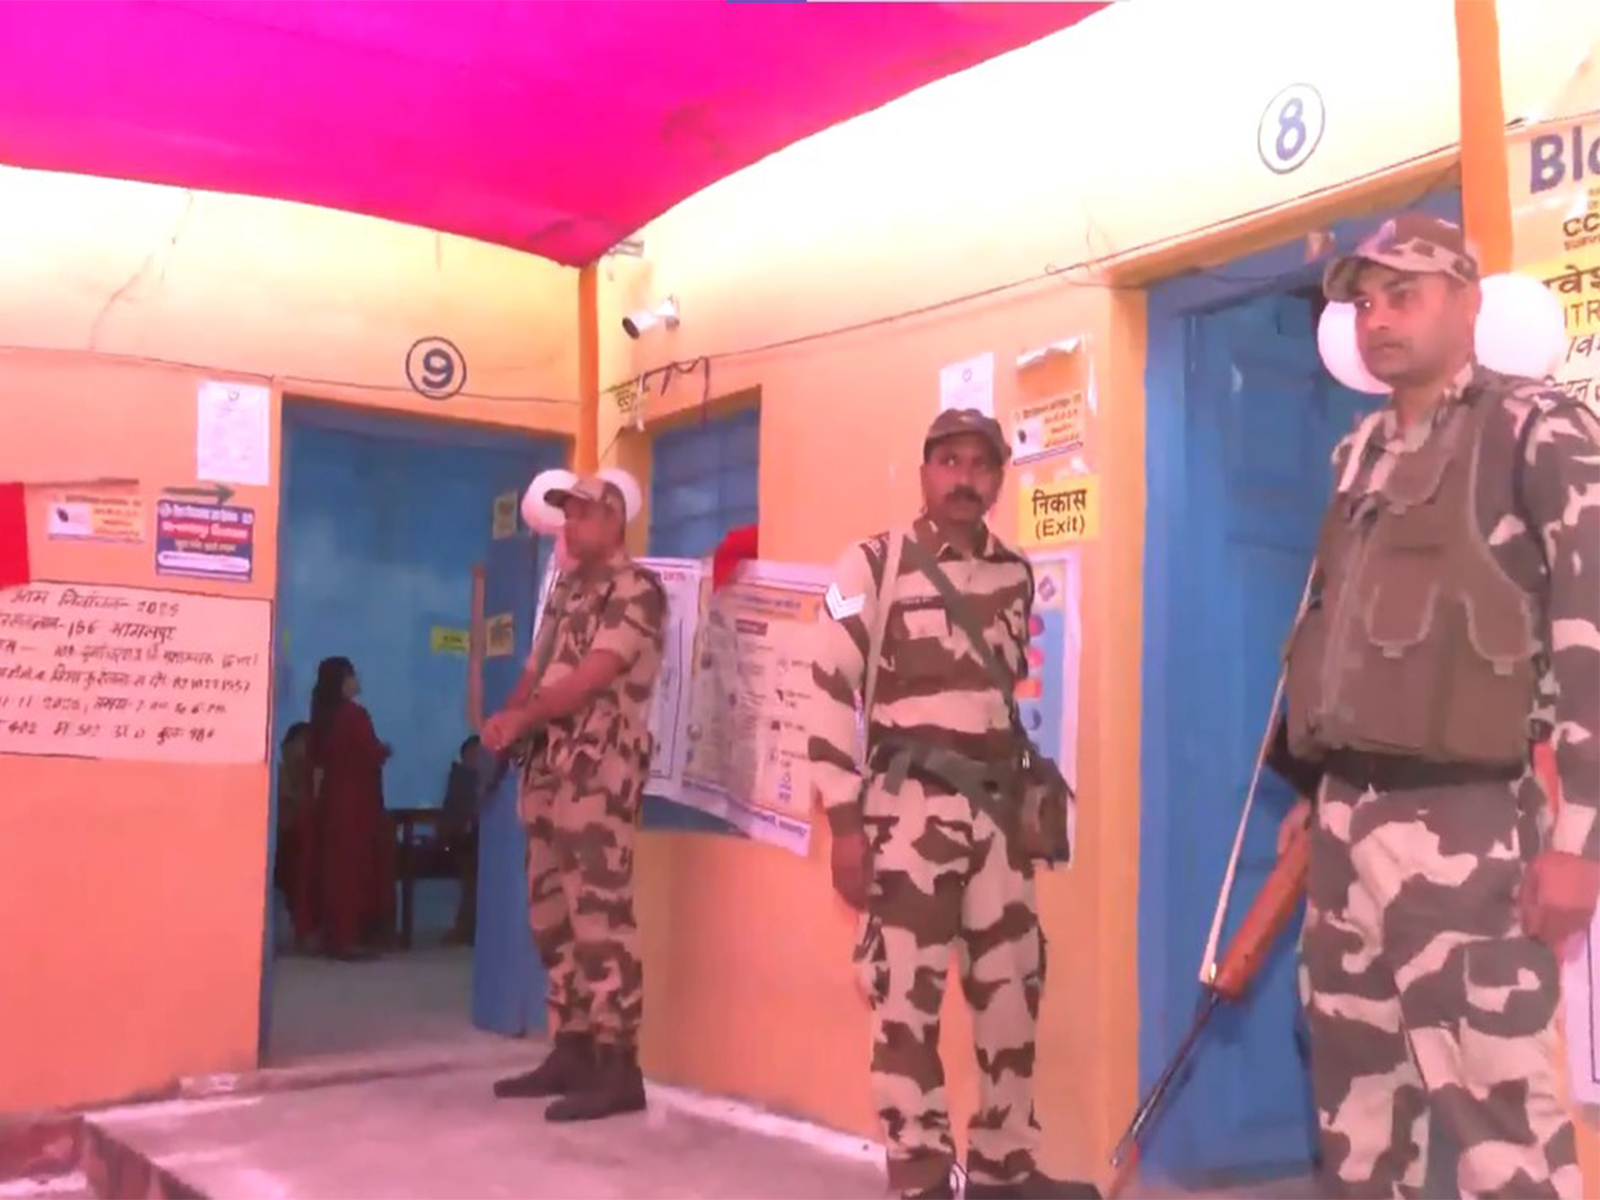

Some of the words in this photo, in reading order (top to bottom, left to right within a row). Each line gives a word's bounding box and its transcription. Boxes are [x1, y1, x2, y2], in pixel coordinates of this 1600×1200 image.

[1276, 97, 1306, 161] 8
[1563, 213, 1600, 236] CC
[422, 348, 454, 390] 9
[1032, 488, 1087, 516] निकास
[1034, 516, 1086, 540] (Exit)
